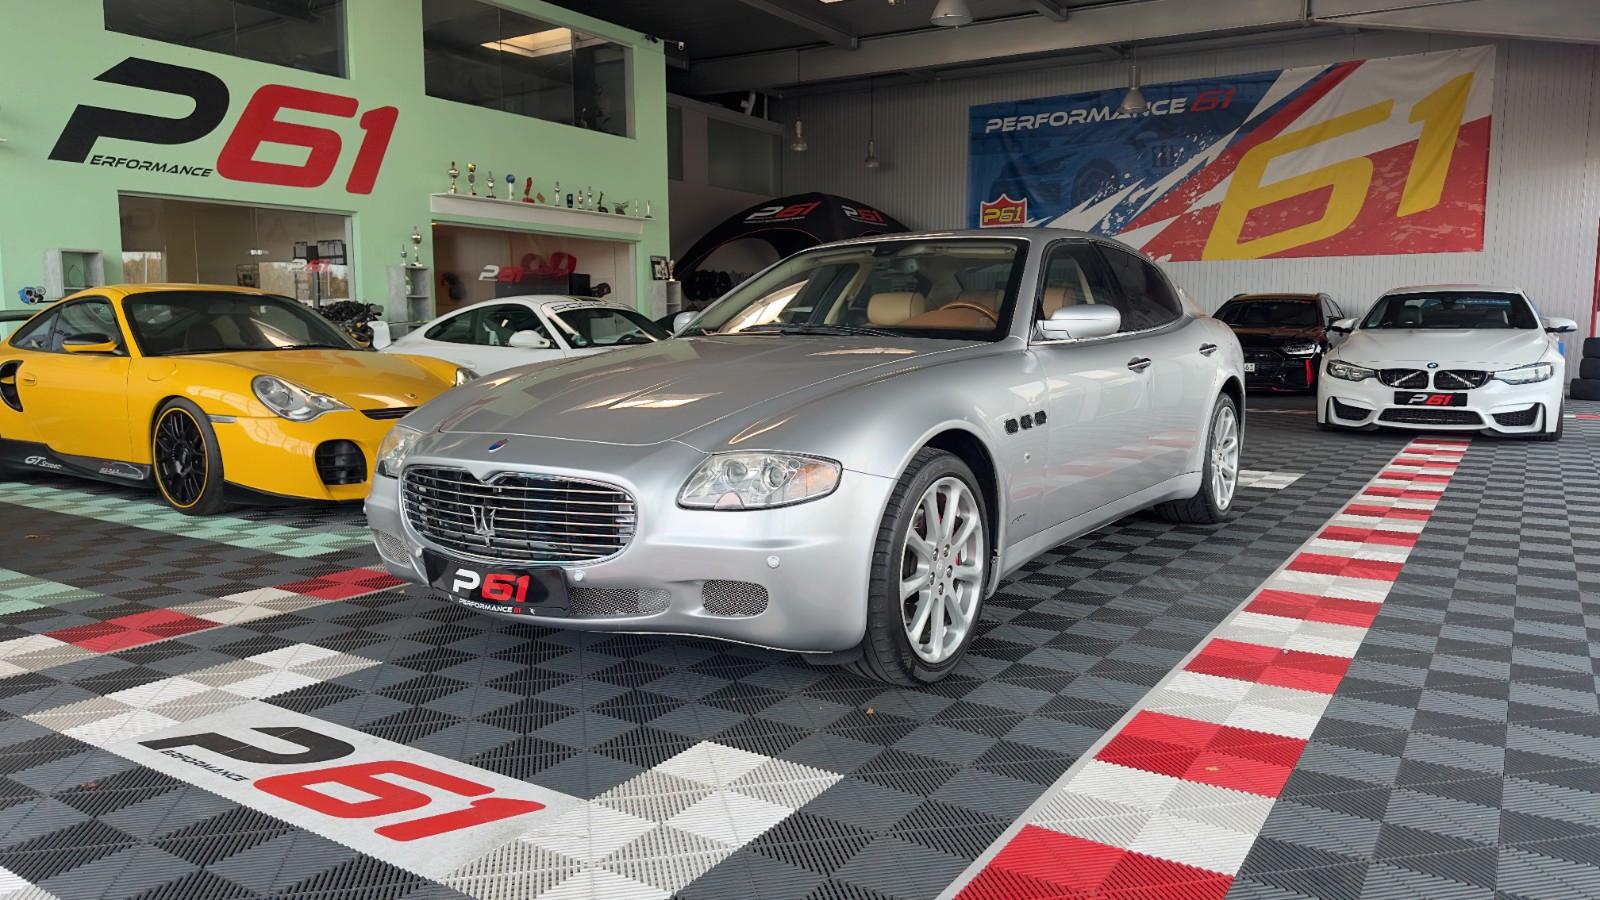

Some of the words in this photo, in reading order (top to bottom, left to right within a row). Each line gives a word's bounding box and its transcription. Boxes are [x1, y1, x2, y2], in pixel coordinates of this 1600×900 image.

[1191, 87, 1236, 113] 61
[1202, 71, 1475, 261] 61
[983, 206, 1023, 223] P61
[1408, 393, 1454, 406] P61
[458, 597, 513, 613] PERFORMANCE
